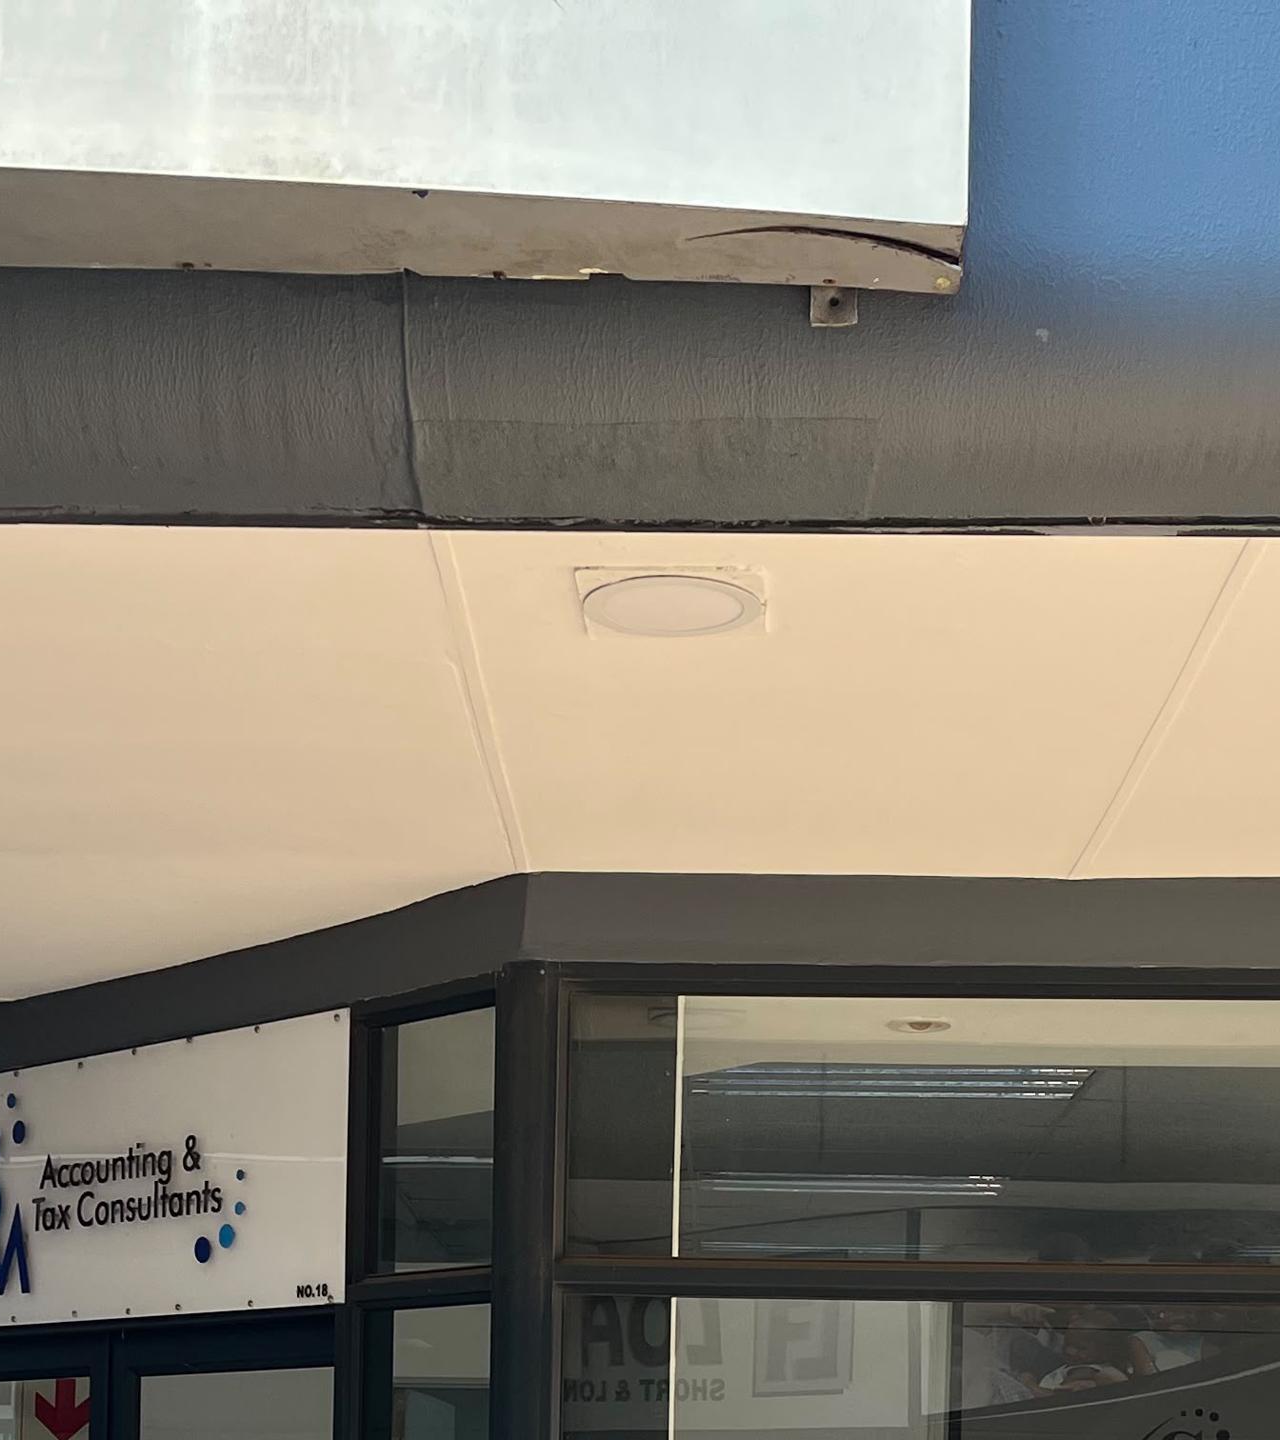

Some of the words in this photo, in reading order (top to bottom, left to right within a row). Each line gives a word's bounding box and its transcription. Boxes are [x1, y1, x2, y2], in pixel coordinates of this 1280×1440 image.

[39, 1143, 173, 1190] Accounting
[183, 1134, 201, 1172] &
[32, 1197, 70, 1232] Tax
[77, 1180, 223, 1229] Consultants
[296, 1283, 329, 1299] NO.18
